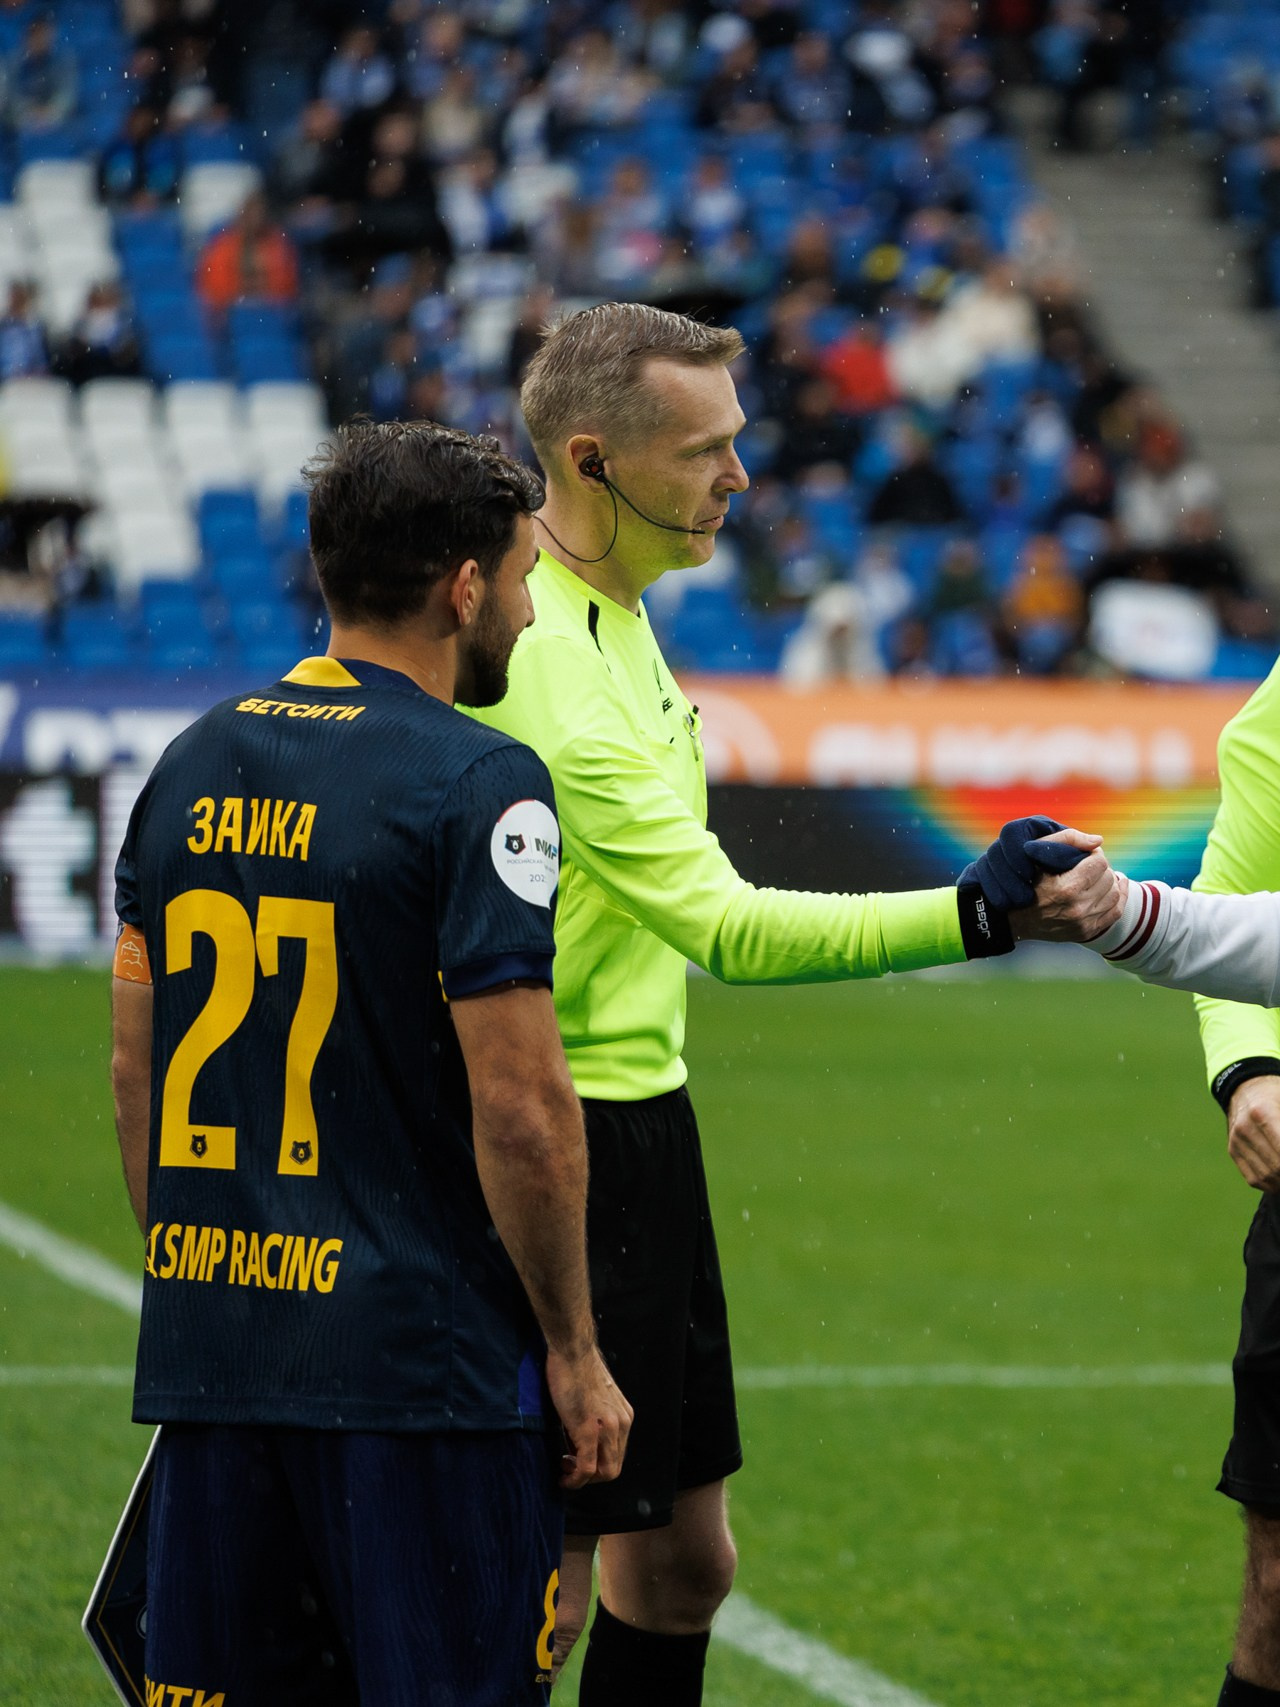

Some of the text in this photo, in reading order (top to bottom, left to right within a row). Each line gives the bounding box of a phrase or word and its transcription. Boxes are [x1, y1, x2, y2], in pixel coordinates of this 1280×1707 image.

[235, 697, 367, 721] БЕТСИТИ
[187, 796, 318, 862] ЗАИКА
[975, 895, 991, 940] JÖGEL
[159, 888, 339, 1176] 27
[159, 1223, 343, 1294] SMP RACING
